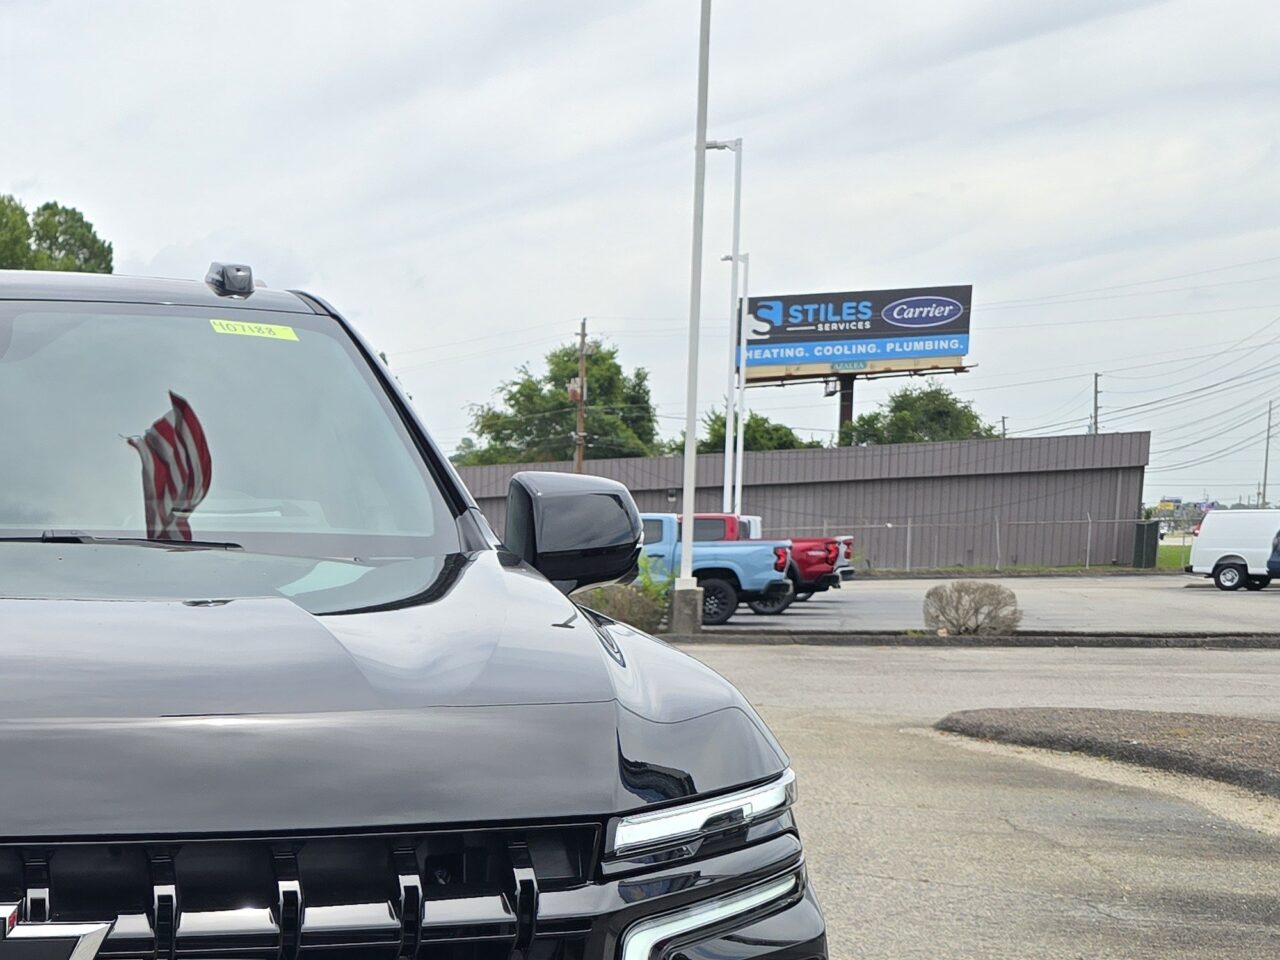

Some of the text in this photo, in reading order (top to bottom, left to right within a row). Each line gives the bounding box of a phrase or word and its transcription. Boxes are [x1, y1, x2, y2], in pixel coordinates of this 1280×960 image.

[788, 301, 873, 323] STILES
[892, 303, 953, 319] Carrier
[817, 321, 871, 331] SERVICES
[814, 344, 880, 356] COOLING.
[886, 339, 964, 352] PLUMBING.
